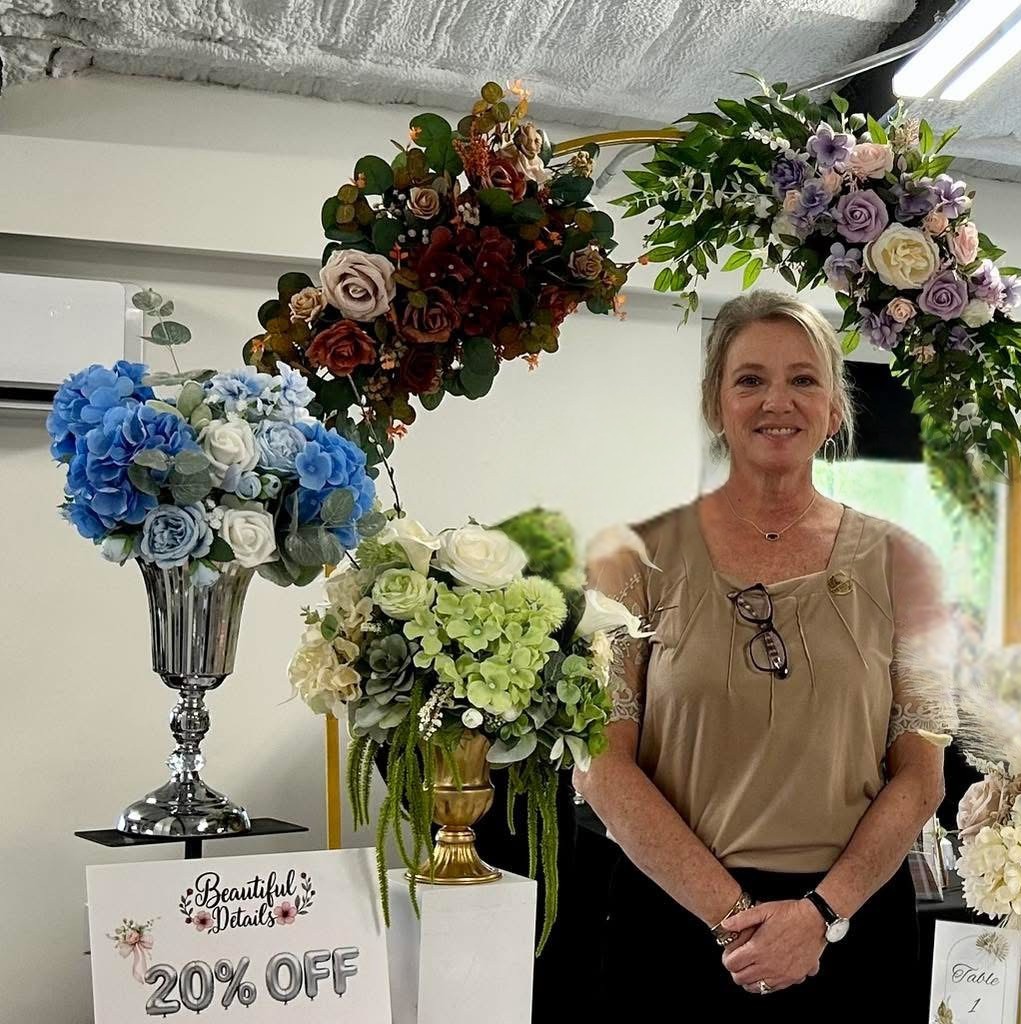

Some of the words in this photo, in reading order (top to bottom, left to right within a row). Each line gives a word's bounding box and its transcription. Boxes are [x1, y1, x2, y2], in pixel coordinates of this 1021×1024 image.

[195, 870, 296, 908] Beautiful
[212, 903, 277, 934] Details
[145, 956, 257, 1017] 20%
[265, 947, 359, 1005] OFF
[952, 963, 1000, 985] Table
[968, 998, 981, 1014] 1
